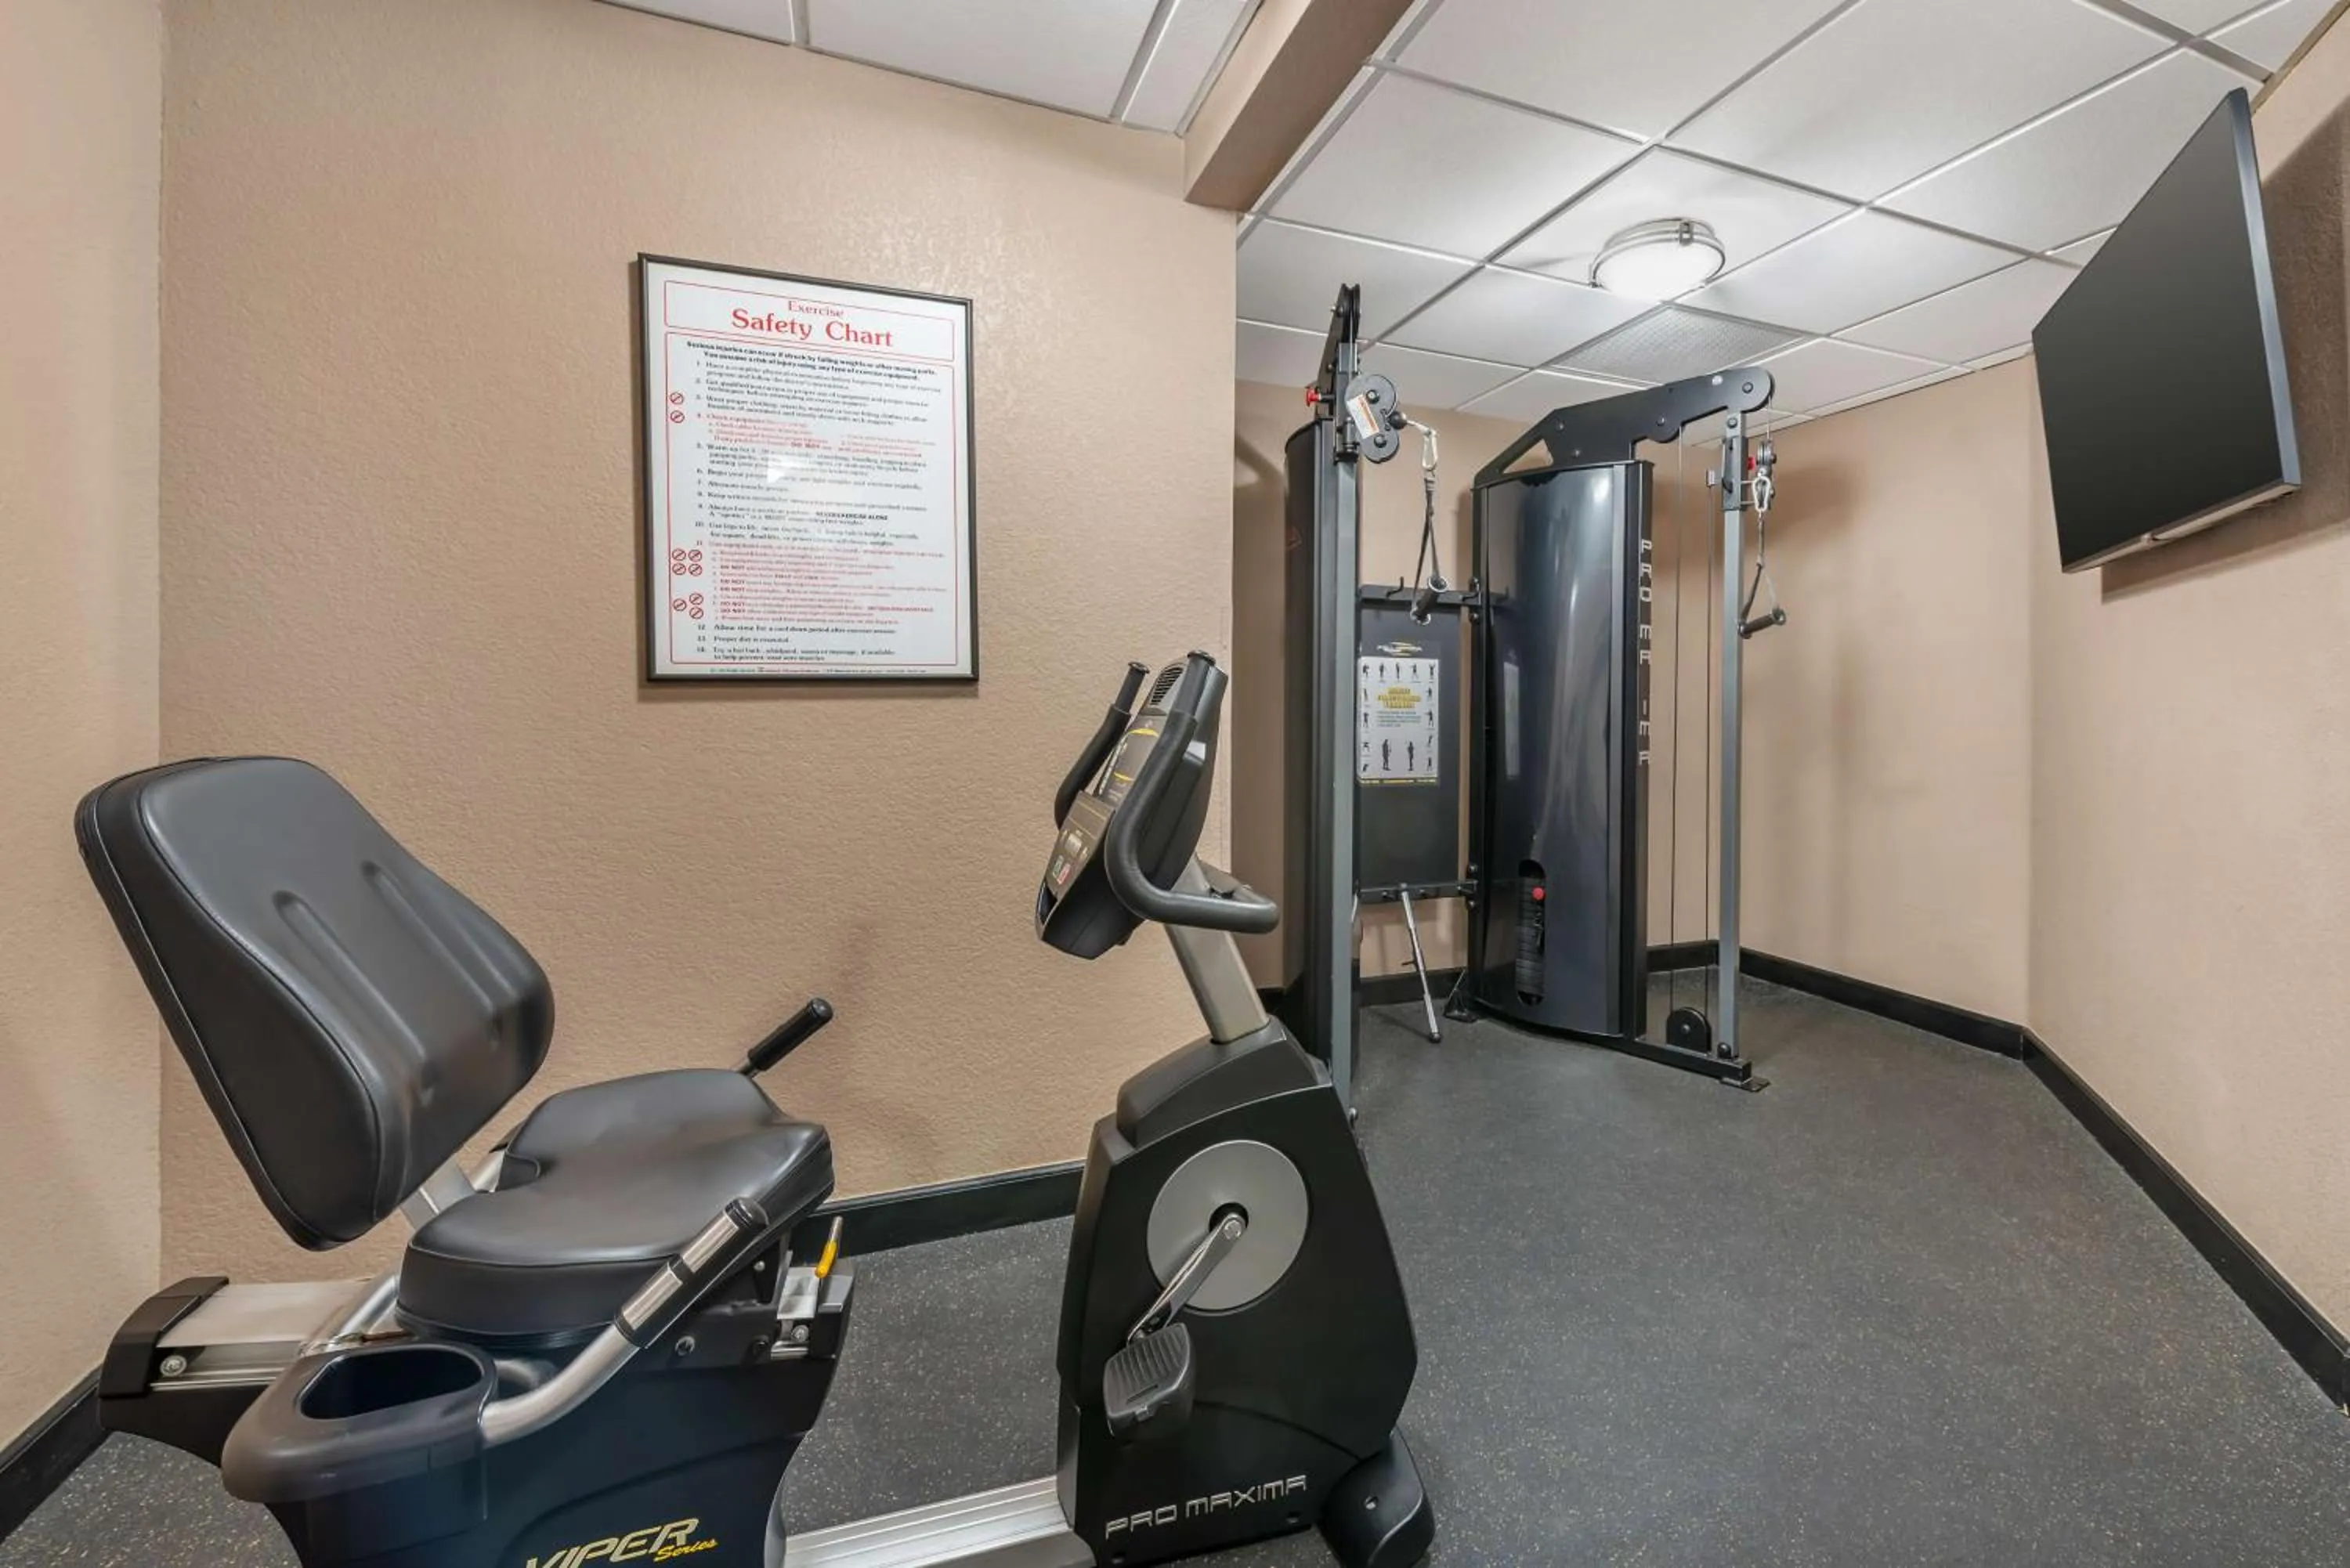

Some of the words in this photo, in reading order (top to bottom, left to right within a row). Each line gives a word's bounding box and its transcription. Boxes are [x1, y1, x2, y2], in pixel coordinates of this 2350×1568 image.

[788, 300, 844, 317] Exercise
[732, 308, 812, 340] Safety
[826, 320, 894, 346] Chart
[1105, 1504, 1177, 1541] PRO
[1185, 1475, 1307, 1518] MAXIMA
[653, 1538, 719, 1563] Series
